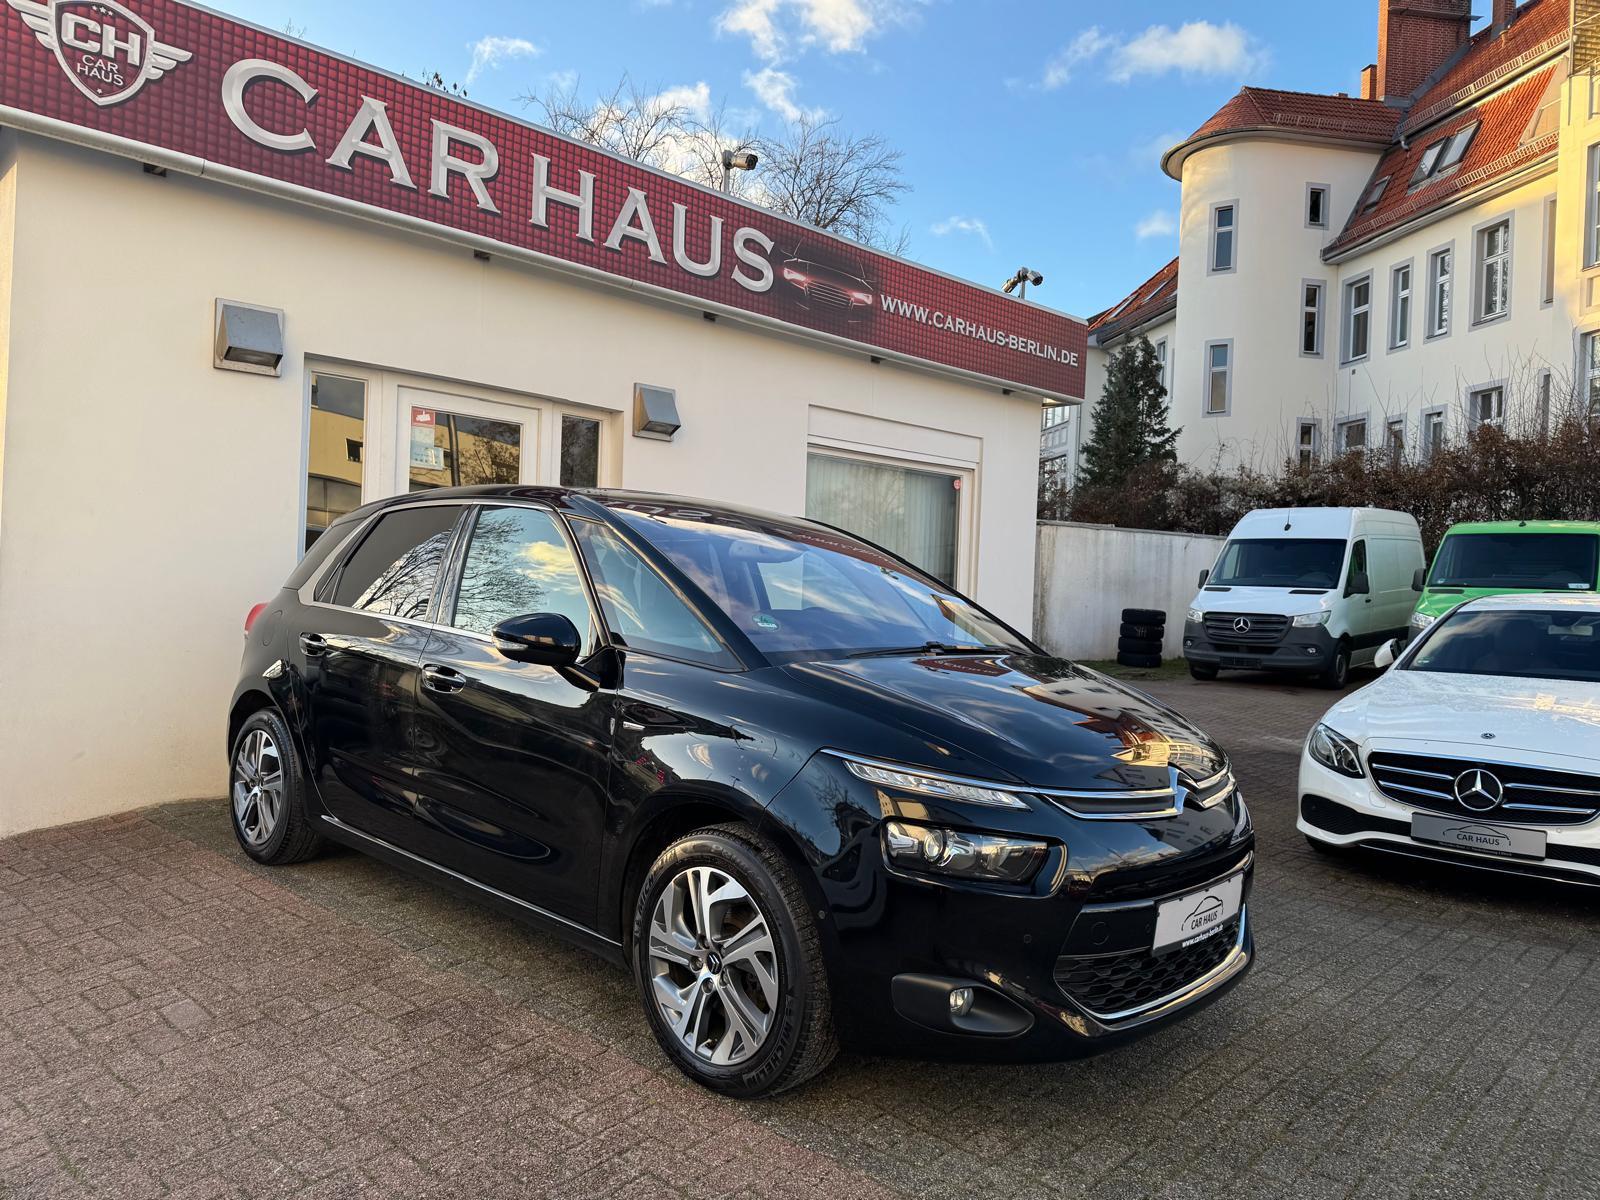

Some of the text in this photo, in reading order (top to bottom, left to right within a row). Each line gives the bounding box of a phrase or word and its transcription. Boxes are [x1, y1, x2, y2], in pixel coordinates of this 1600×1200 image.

[61, 12, 141, 66] CH
[76, 62, 124, 86] HAUS
[82, 54, 119, 73] CAR
[221, 58, 775, 293] CAR HAUS
[880, 294, 1079, 367] WWW.CARHAUS-BERLIN.DE
[1456, 833, 1500, 846] CAR HAUS
[1190, 911, 1218, 930] CAR HAUS
